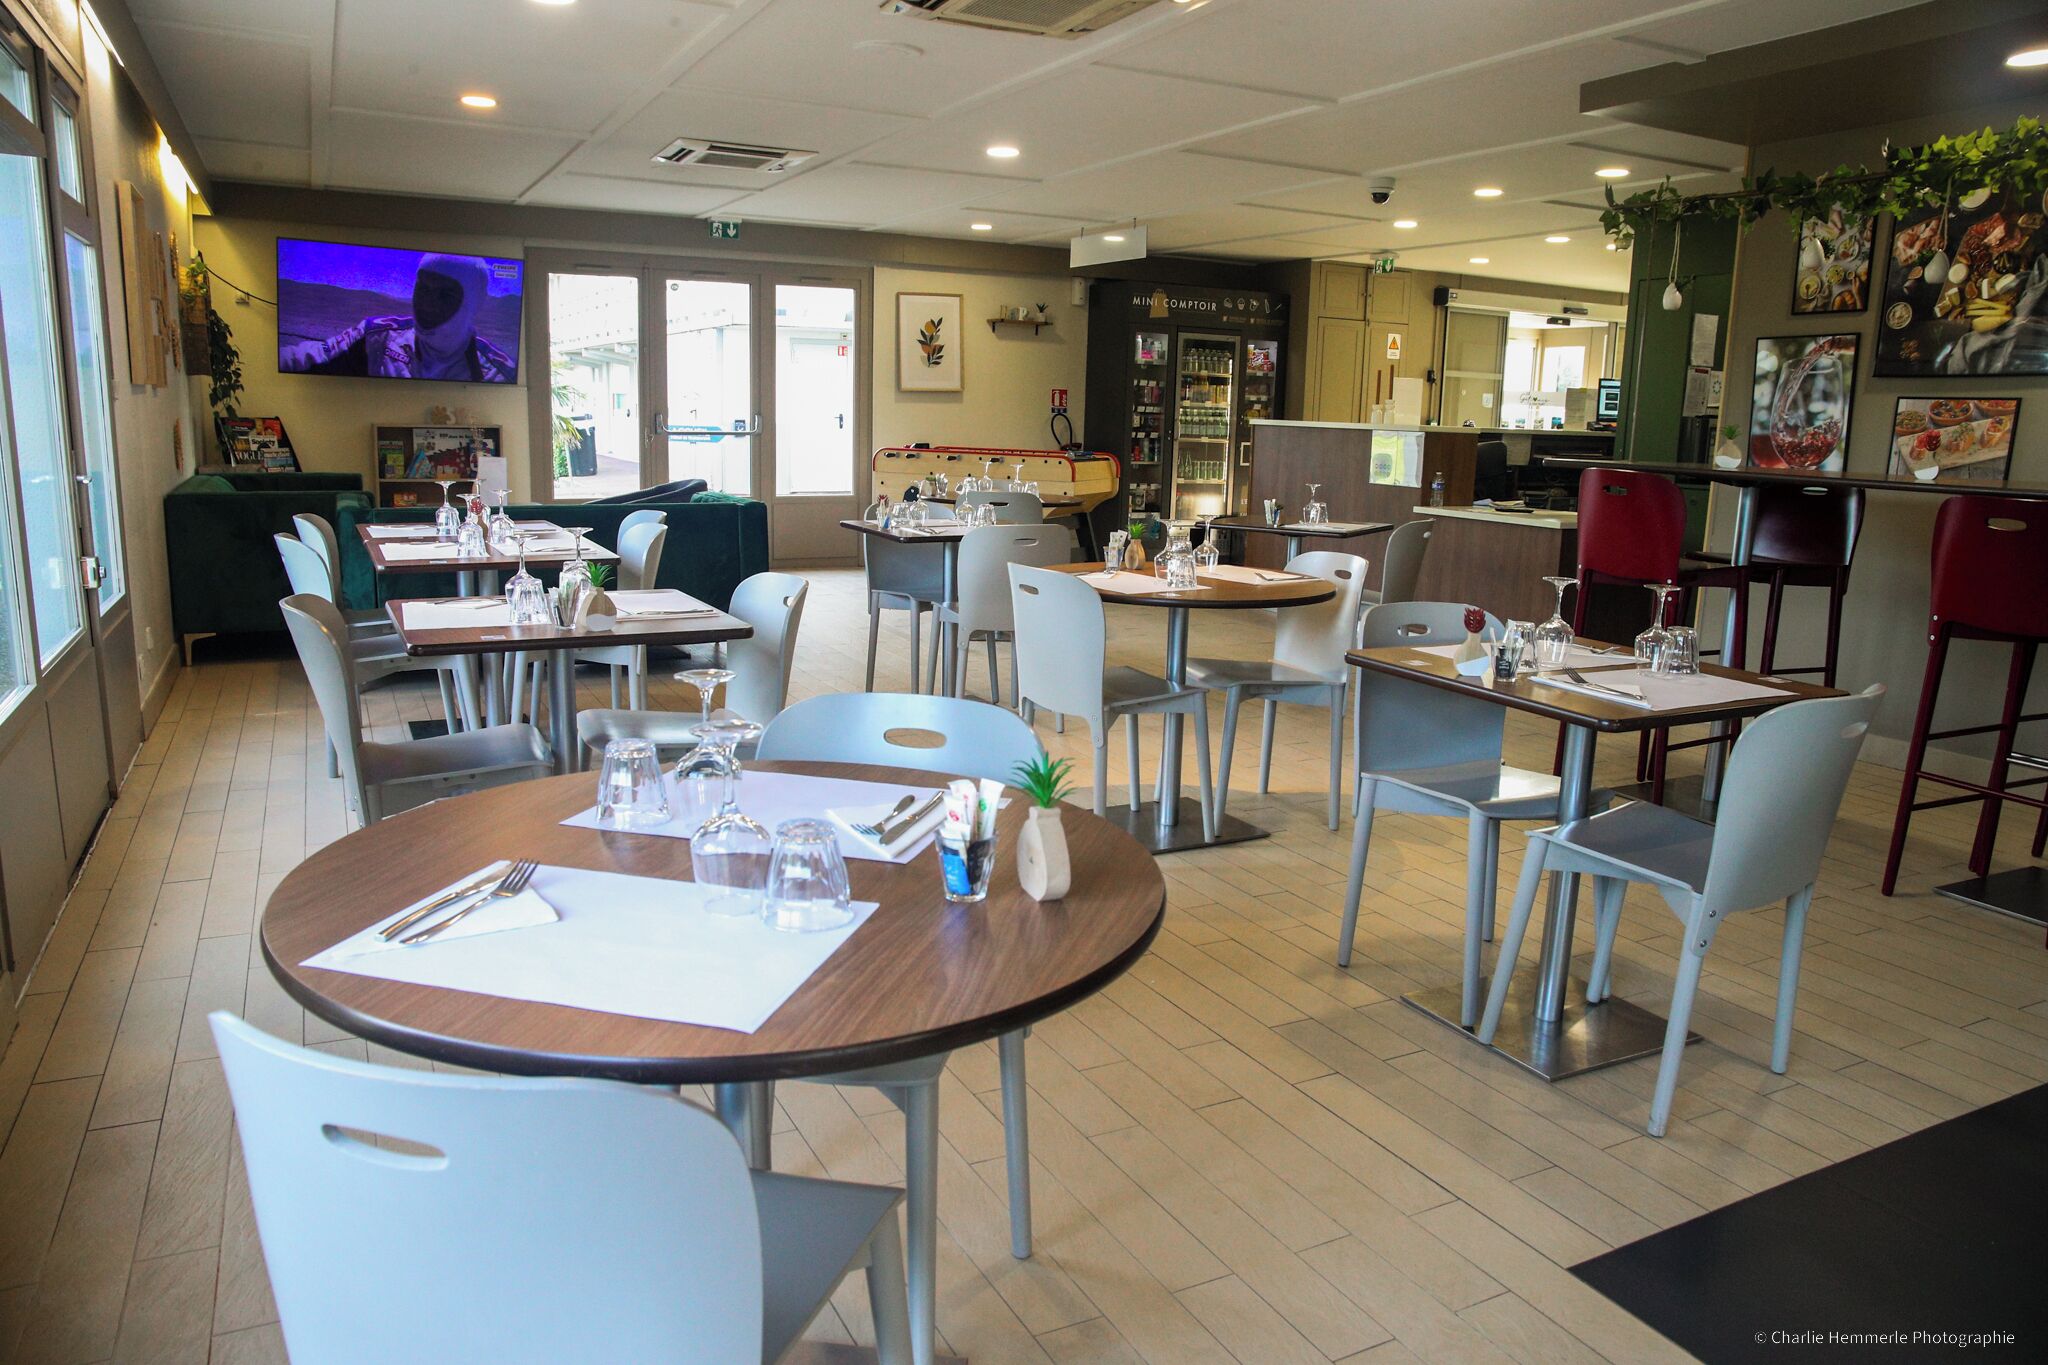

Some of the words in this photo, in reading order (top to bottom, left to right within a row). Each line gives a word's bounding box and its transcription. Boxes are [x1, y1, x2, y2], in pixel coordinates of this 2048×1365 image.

[1132, 296, 1158, 306] MINI
[1163, 298, 1217, 311] COMPTOIR
[252, 438, 276, 446] Society
[235, 450, 264, 460] VOGUE
